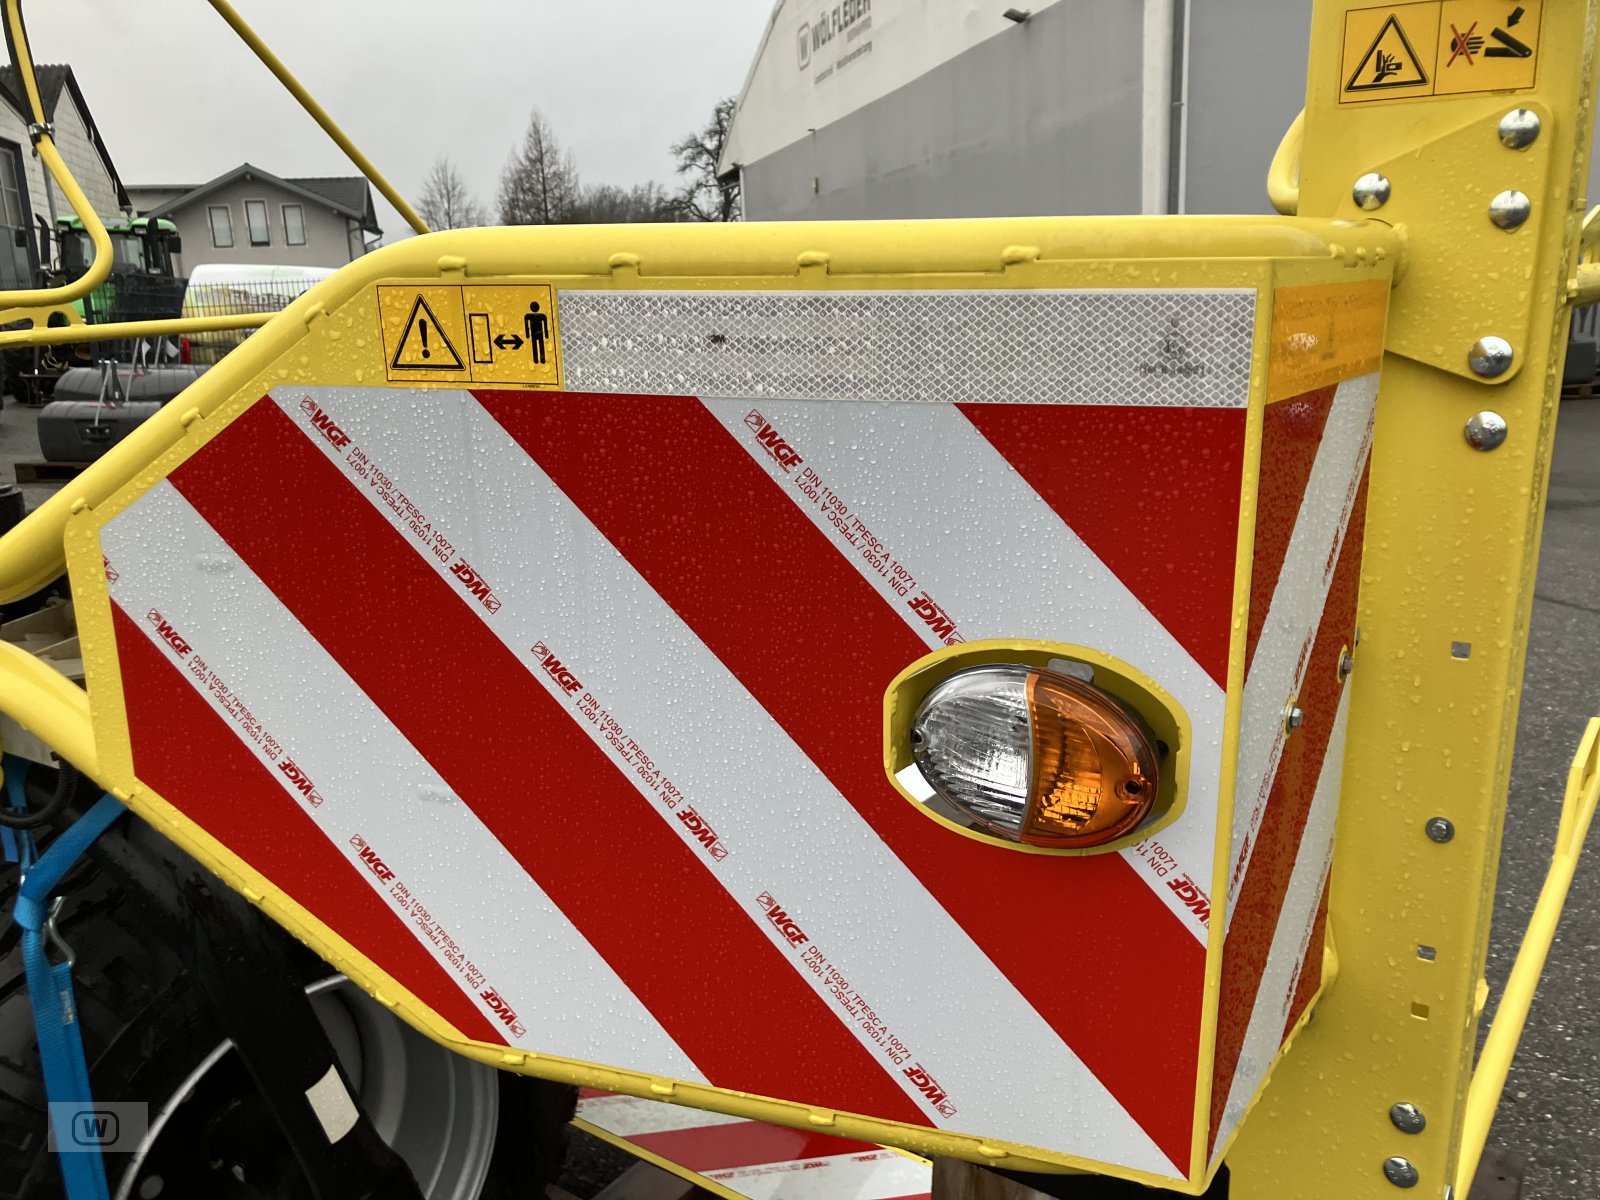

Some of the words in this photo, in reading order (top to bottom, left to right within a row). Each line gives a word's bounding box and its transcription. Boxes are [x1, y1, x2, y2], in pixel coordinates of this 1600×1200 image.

[312, 408, 351, 447] WGF
[757, 424, 803, 467] WGF
[346, 454, 369, 479] 10071
[371, 478, 378, 486] A
[794, 475, 820, 503] 10071
[352, 447, 369, 465] DIN
[370, 465, 392, 489] 11030
[397, 492, 425, 524] TPESC
[423, 524, 431, 532] A
[433, 531, 455, 556] 10071
[376, 486, 404, 517] TPESC
[821, 502, 830, 511] A
[409, 520, 432, 545] 11030
[803, 467, 822, 488] DIN
[822, 487, 847, 515] 11030
[852, 518, 883, 553] TPESC
[880, 553, 890, 563] A
[890, 561, 916, 589] 10071
[828, 511, 858, 546] TPESC
[432, 545, 449, 563] DIN
[863, 550, 889, 577] 11030
[449, 563, 490, 601] WGF
[888, 577, 908, 597] DIN
[907, 597, 953, 639] WGF
[158, 620, 192, 654] WGF
[188, 661, 208, 684] 10071
[543, 654, 583, 692] WGF
[193, 655, 208, 671] DIN
[208, 671, 228, 694] 11030
[232, 697, 256, 725] TPESC
[255, 725, 261, 733] A
[263, 732, 283, 754] 10071
[214, 690, 238, 719] TPESC
[576, 699, 599, 724] 10071
[243, 722, 262, 744] 11030
[600, 723, 608, 731] A
[263, 744, 277, 760] DIN
[583, 693, 600, 710] DIN
[600, 711, 622, 735] 11030
[627, 739, 654, 770] TPESC
[652, 770, 660, 778] A
[661, 778, 684, 802] 10071
[606, 732, 633, 763] TPESC
[278, 761, 313, 796] WGF
[637, 766, 660, 791] 11030
[659, 791, 676, 809] DIN
[676, 810, 716, 848] WGF
[360, 846, 395, 880] WGF
[1147, 857, 1168, 877] DIN
[1150, 841, 1178, 870] 10071
[390, 888, 410, 910] 10071
[1166, 879, 1211, 922] WGF
[396, 882, 411, 898] DIN
[411, 899, 431, 921] 11030
[435, 925, 459, 953] TPESC
[465, 961, 486, 984] 10071
[416, 917, 441, 946] TPESC
[767, 905, 809, 944] WGF
[444, 950, 464, 972] 11030
[800, 952, 824, 977] 10071
[465, 973, 479, 989] DIN
[480, 991, 516, 1025] WGF
[808, 946, 826, 964] DIN
[825, 964, 849, 990] 11030
[853, 994, 881, 1026] TPESC
[879, 1027, 887, 1035] A
[888, 1034, 911, 1059] 10071
[830, 986, 858, 1017] TPESC
[862, 1022, 886, 1046] 11030
[885, 1047, 903, 1065] DIN
[903, 1067, 945, 1105] WGF
